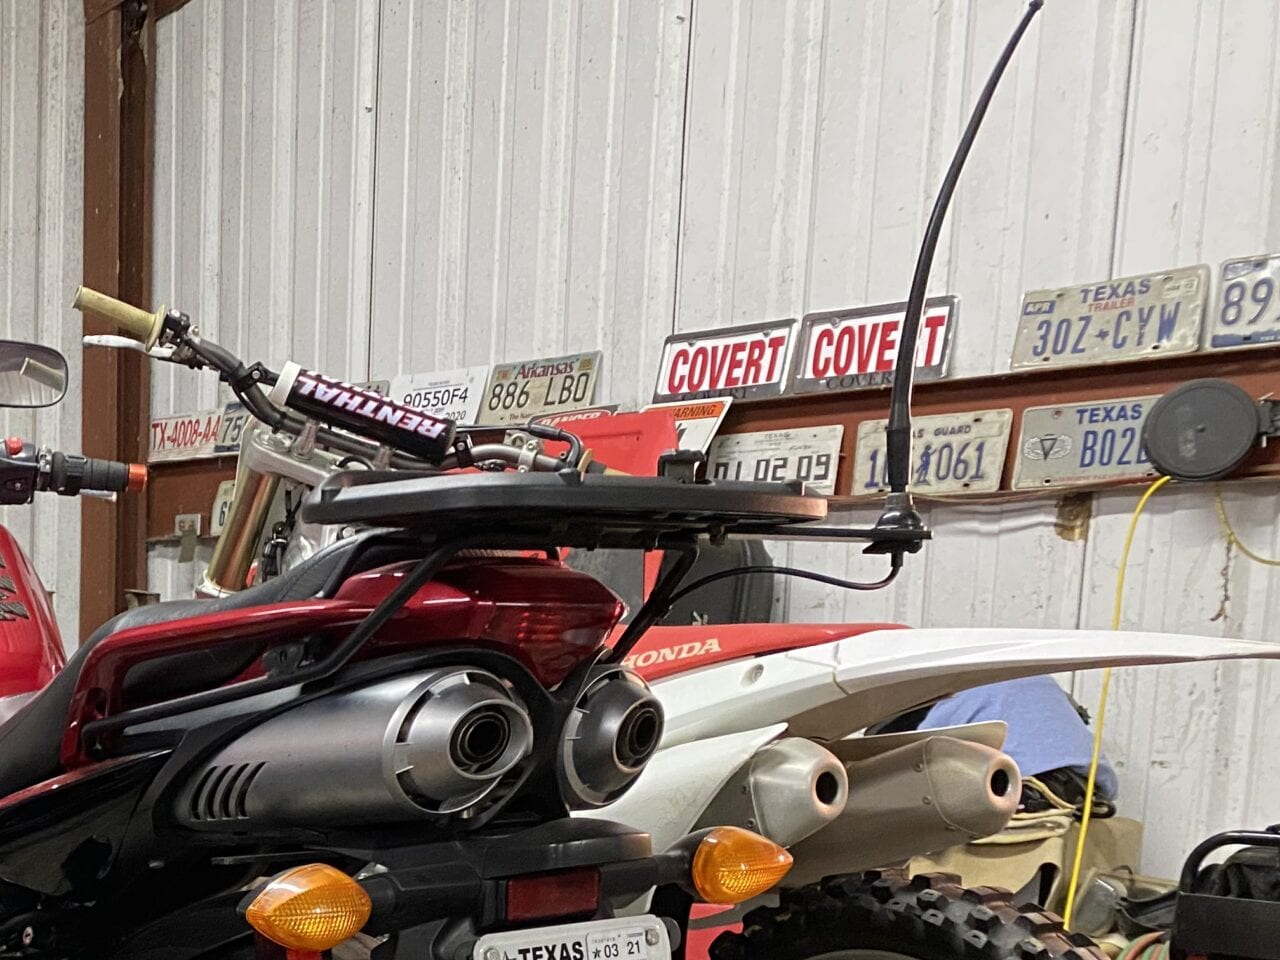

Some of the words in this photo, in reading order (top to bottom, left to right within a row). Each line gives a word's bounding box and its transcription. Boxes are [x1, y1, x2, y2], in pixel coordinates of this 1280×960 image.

[1081, 279, 1151, 303] TEXAS
[1222, 278, 1280, 326] 89
[1088, 298, 1136, 312] TRAILER
[812, 315, 946, 378] COVET
[514, 361, 575, 380] Arkansas
[668, 336, 786, 394] COVERT
[826, 372, 893, 390] COVER
[298, 375, 447, 439] RENTHAL
[403, 386, 468, 409] 90550F4
[489, 380, 530, 411] 886
[673, 405, 717, 418] ARNING
[1077, 404, 1143, 425] TEXAS
[222, 415, 250, 443] 75
[934, 425, 971, 437] GUARD
[754, 457, 788, 481] 02
[796, 453, 831, 481] 09
[620, 638, 721, 668] HONDA
[604, 943, 619, 958] 03
[626, 940, 641, 955] 21
